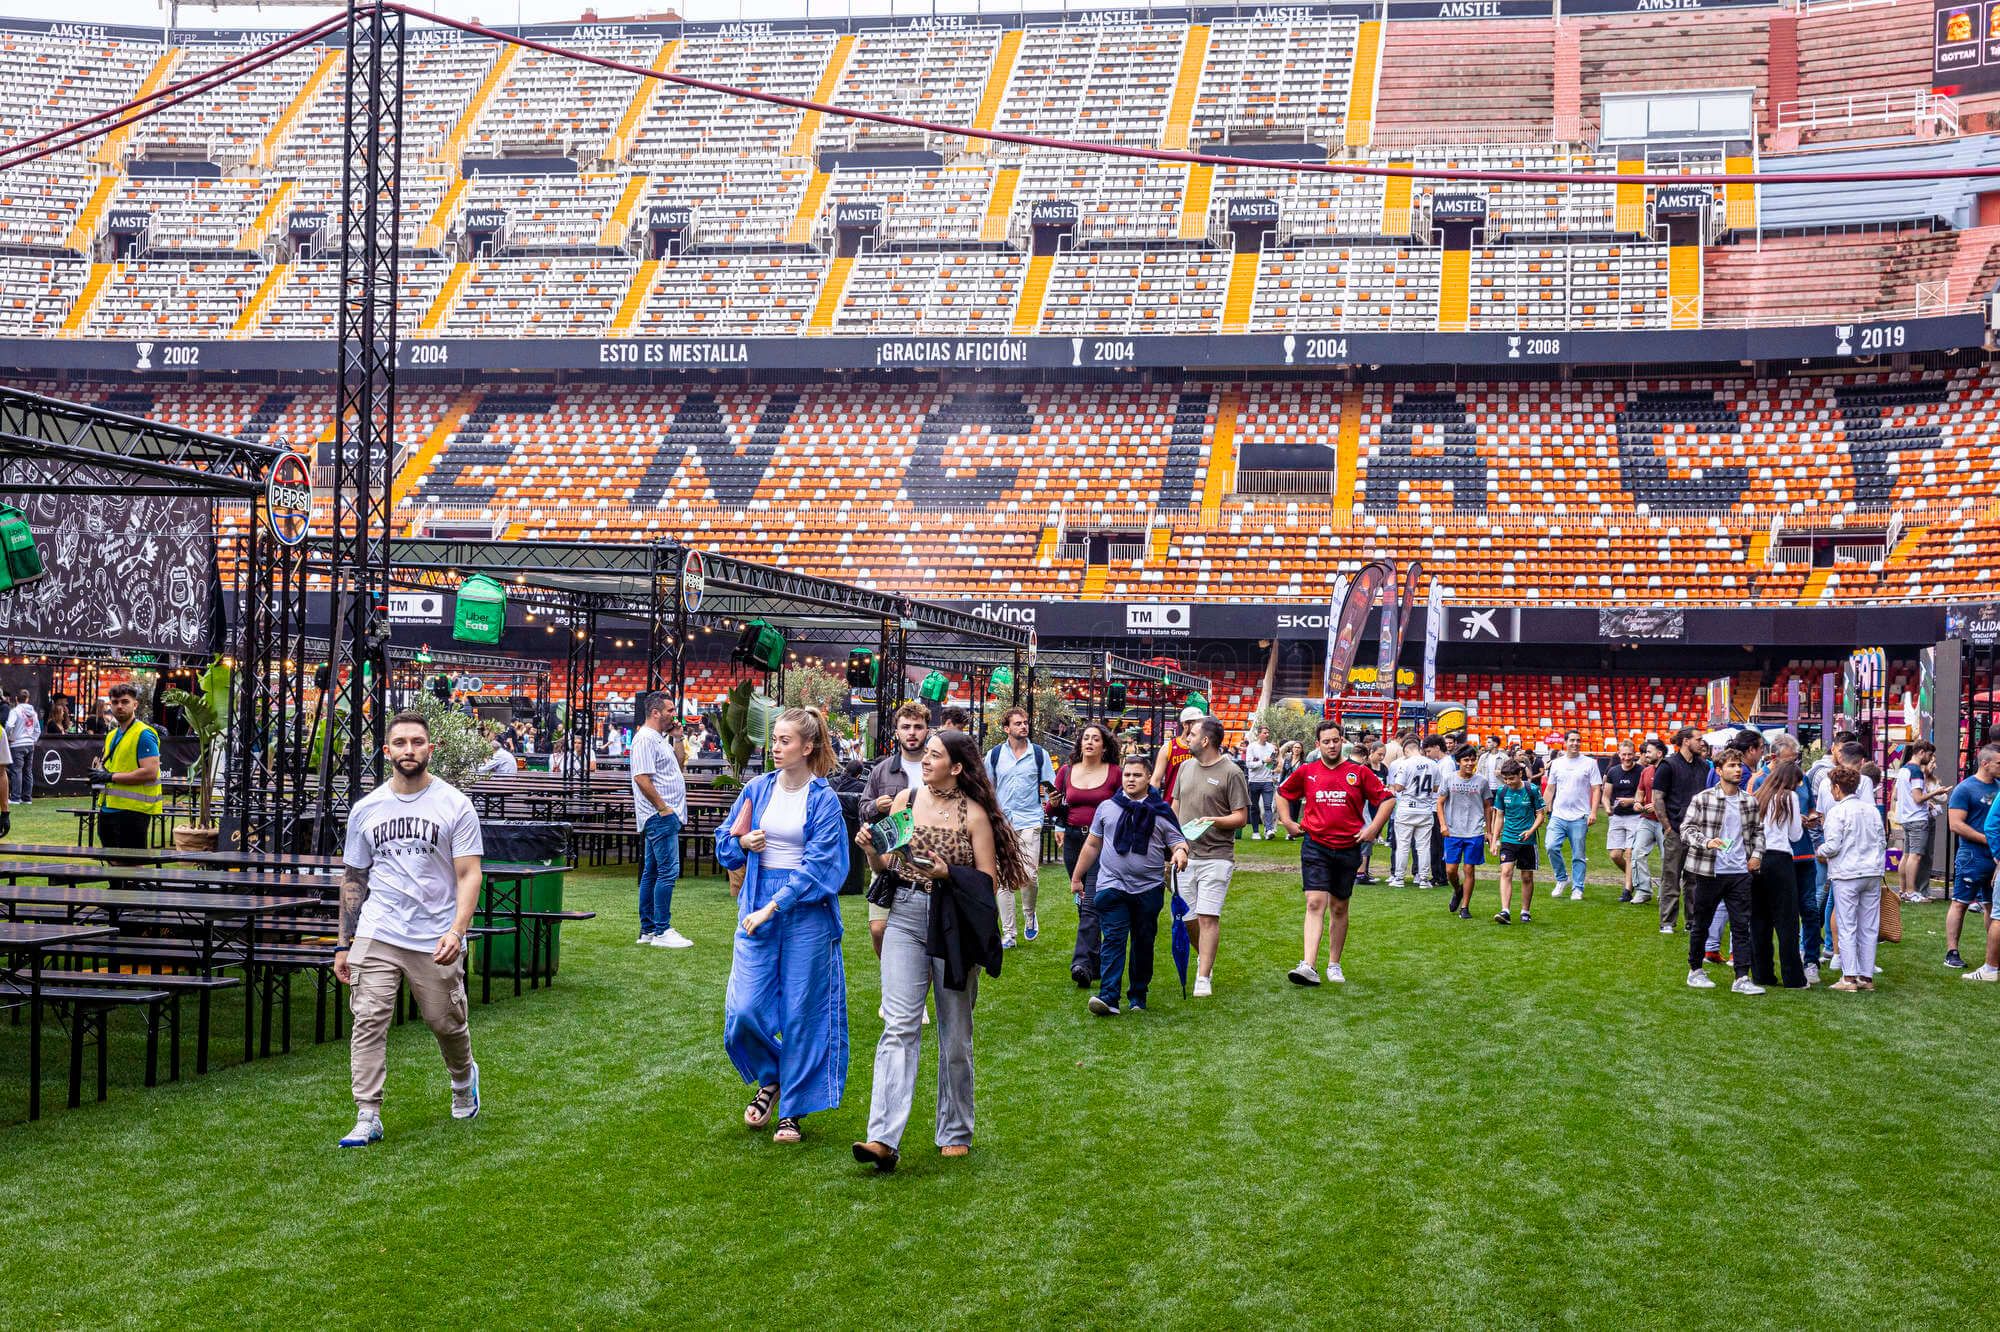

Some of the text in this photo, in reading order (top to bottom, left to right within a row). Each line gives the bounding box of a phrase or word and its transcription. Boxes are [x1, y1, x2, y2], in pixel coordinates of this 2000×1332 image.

[1253, 7, 1312, 21] AMSTEL
[1439, 2, 1501, 17] AMSTEL
[909, 16, 967, 31] AMSTEL
[1079, 11, 1139, 26] AMSTEL
[50, 24, 107, 39] AMSTEL
[411, 30, 464, 44] AMSTEL
[572, 26, 628, 40] AMSTEL
[718, 23, 774, 37] AMSTEL
[239, 32, 293, 46] AMST
[1434, 200, 1484, 213] AMSTEL
[1658, 195, 1711, 207] AMSTEL
[1033, 206, 1078, 219] AMSTEL
[1230, 204, 1278, 217] AMSTEL
[111, 216, 149, 228] AMSTE
[291, 217, 328, 228] AMSTE
[467, 215, 506, 226] AMSTE
[651, 213, 691, 224] AMSTE
[1862, 327, 1905, 350] 2019
[600, 344, 748, 362] ESTO ES MESTALLA
[876, 339, 1027, 365] ¡GRACIAS AFICIÓN!
[1094, 342, 1134, 360] 2004
[1306, 339, 1348, 359] 2004
[1527, 339, 1560, 355] 2008
[164, 347, 199, 364] 2002
[411, 346, 448, 364] 2004
[271, 485, 311, 513] PEPSI
[390, 600, 408, 612] TM
[971, 603, 1036, 623] divina
[424, 617, 442, 625] Group
[466, 611, 489, 622] Uber
[1131, 611, 1152, 622] TM
[1277, 615, 1330, 628] SKO
[465, 620, 489, 632] Eats
[1970, 620, 2000, 632] SALIDA
[44, 763, 61, 771] PEPSI
[1411, 774, 1433, 797] 14
[372, 816, 440, 849] BROOKLYN
[381, 846, 435, 857] NEW YORK
